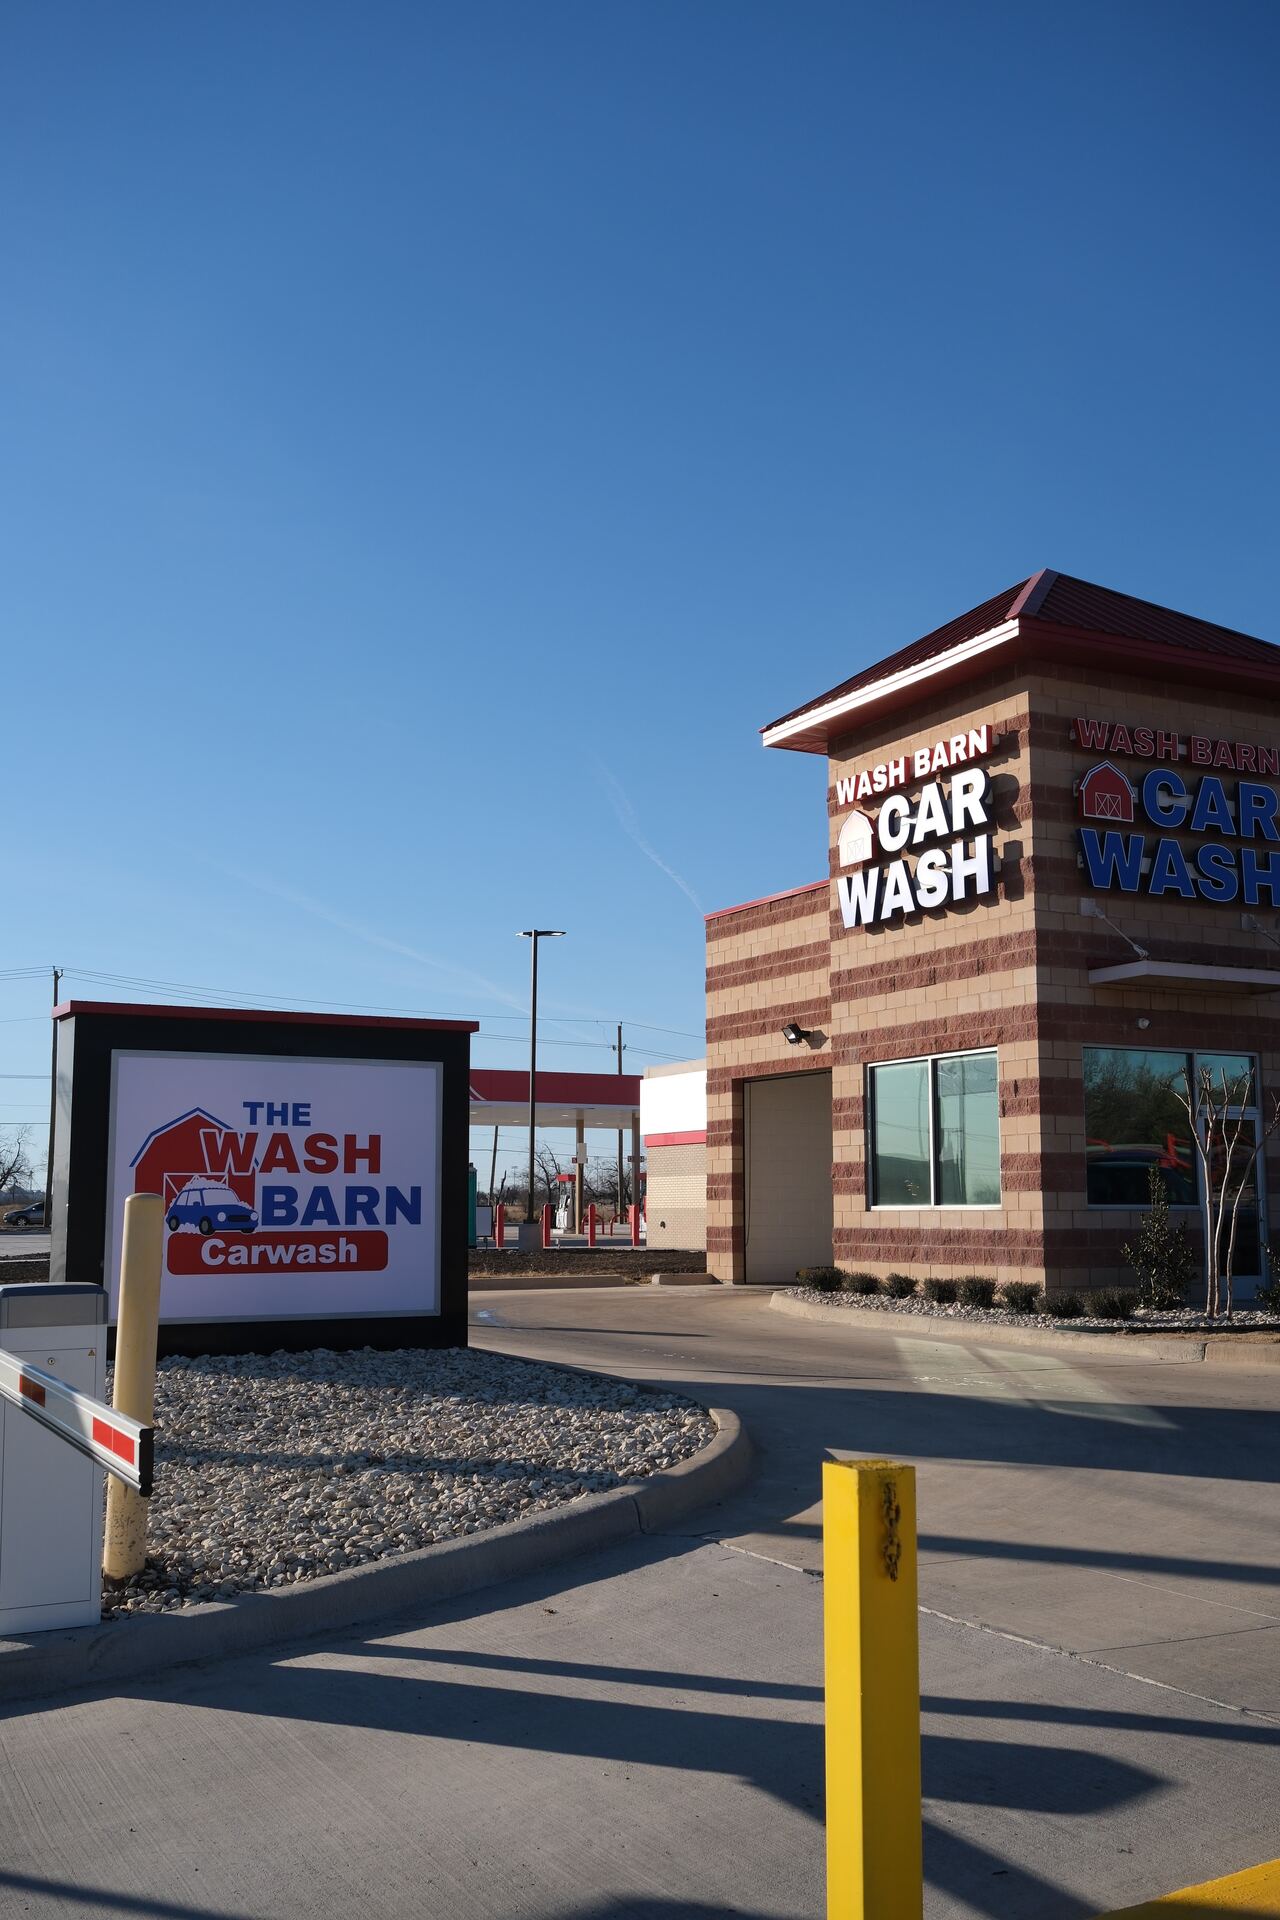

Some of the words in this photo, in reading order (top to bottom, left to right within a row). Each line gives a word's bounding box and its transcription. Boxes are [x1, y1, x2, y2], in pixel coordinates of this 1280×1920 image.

[836, 757, 909, 806] WASH
[914, 724, 991, 778] BARN
[1076, 718, 1179, 761] WASH
[1191, 735, 1280, 776] BARN
[878, 767, 991, 852] CAR
[1142, 768, 1280, 841] CAR
[836, 833, 991, 929] WASH
[1080, 828, 1280, 907] WASH
[243, 1102, 311, 1127] THE
[201, 1129, 381, 1174] WASH
[261, 1186, 421, 1226] BARN
[201, 1237, 357, 1266] Carwash
